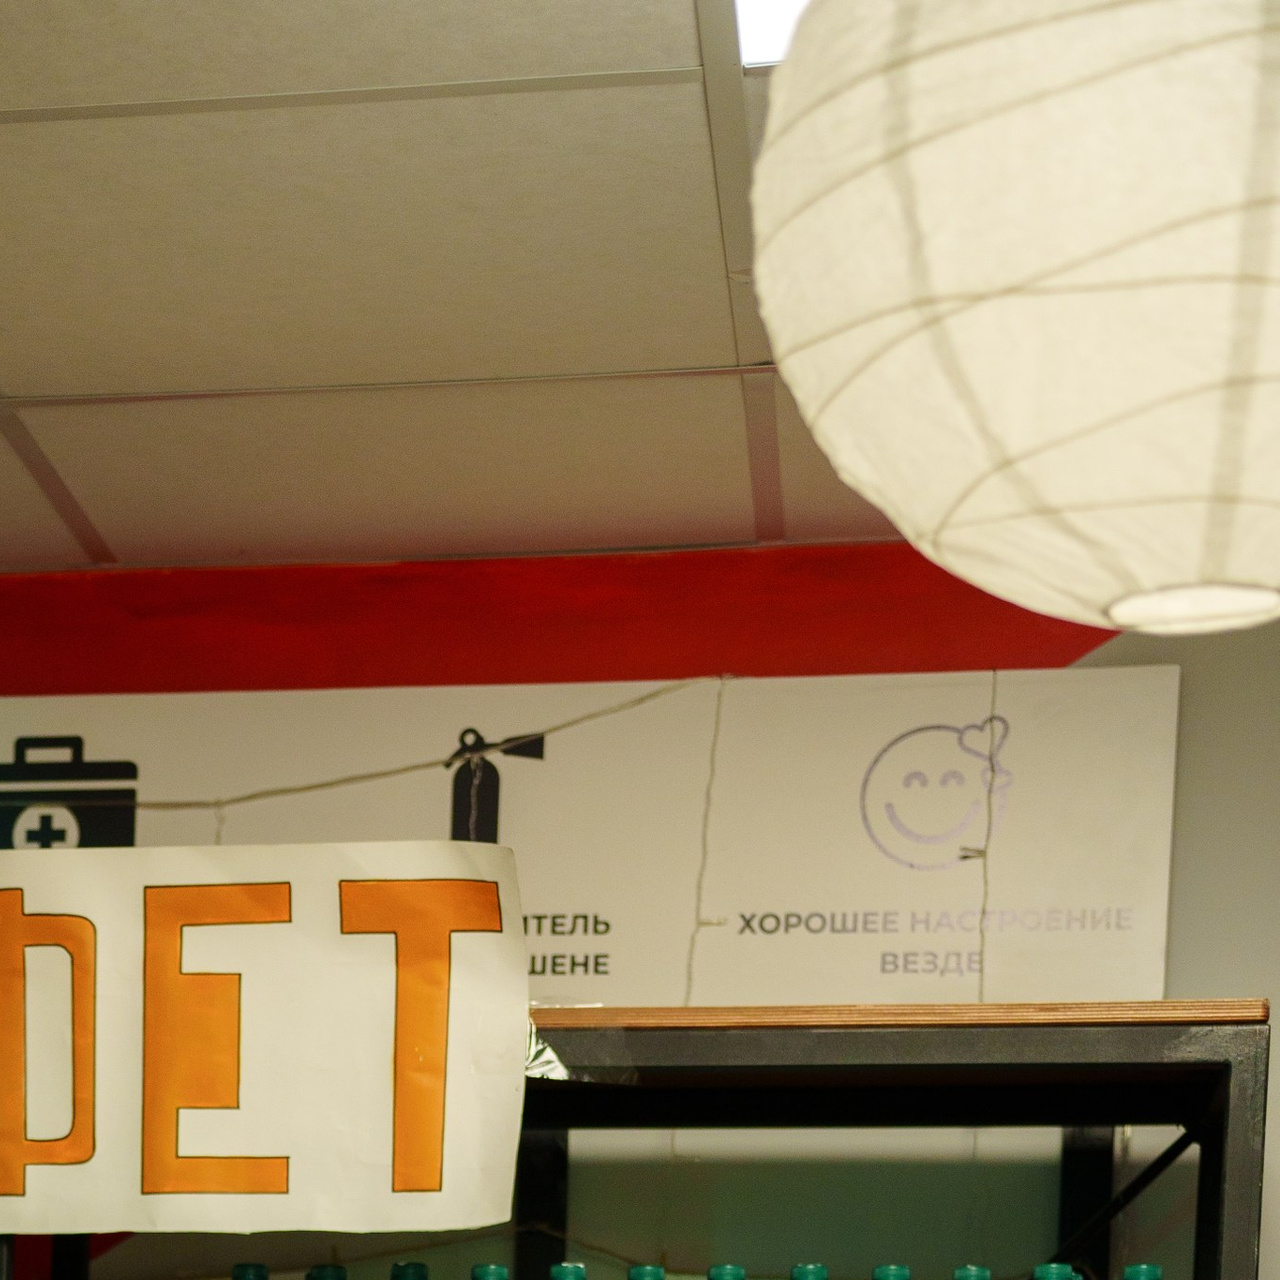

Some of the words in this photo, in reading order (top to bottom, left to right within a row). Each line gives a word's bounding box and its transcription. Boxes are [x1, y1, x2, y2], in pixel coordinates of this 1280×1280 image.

[737, 911, 899, 935] ХОРОШЕЕ
[910, 907, 1133, 934] НАСТРОЕНИЕ
[880, 951, 983, 977] ВЕЗДЕ
